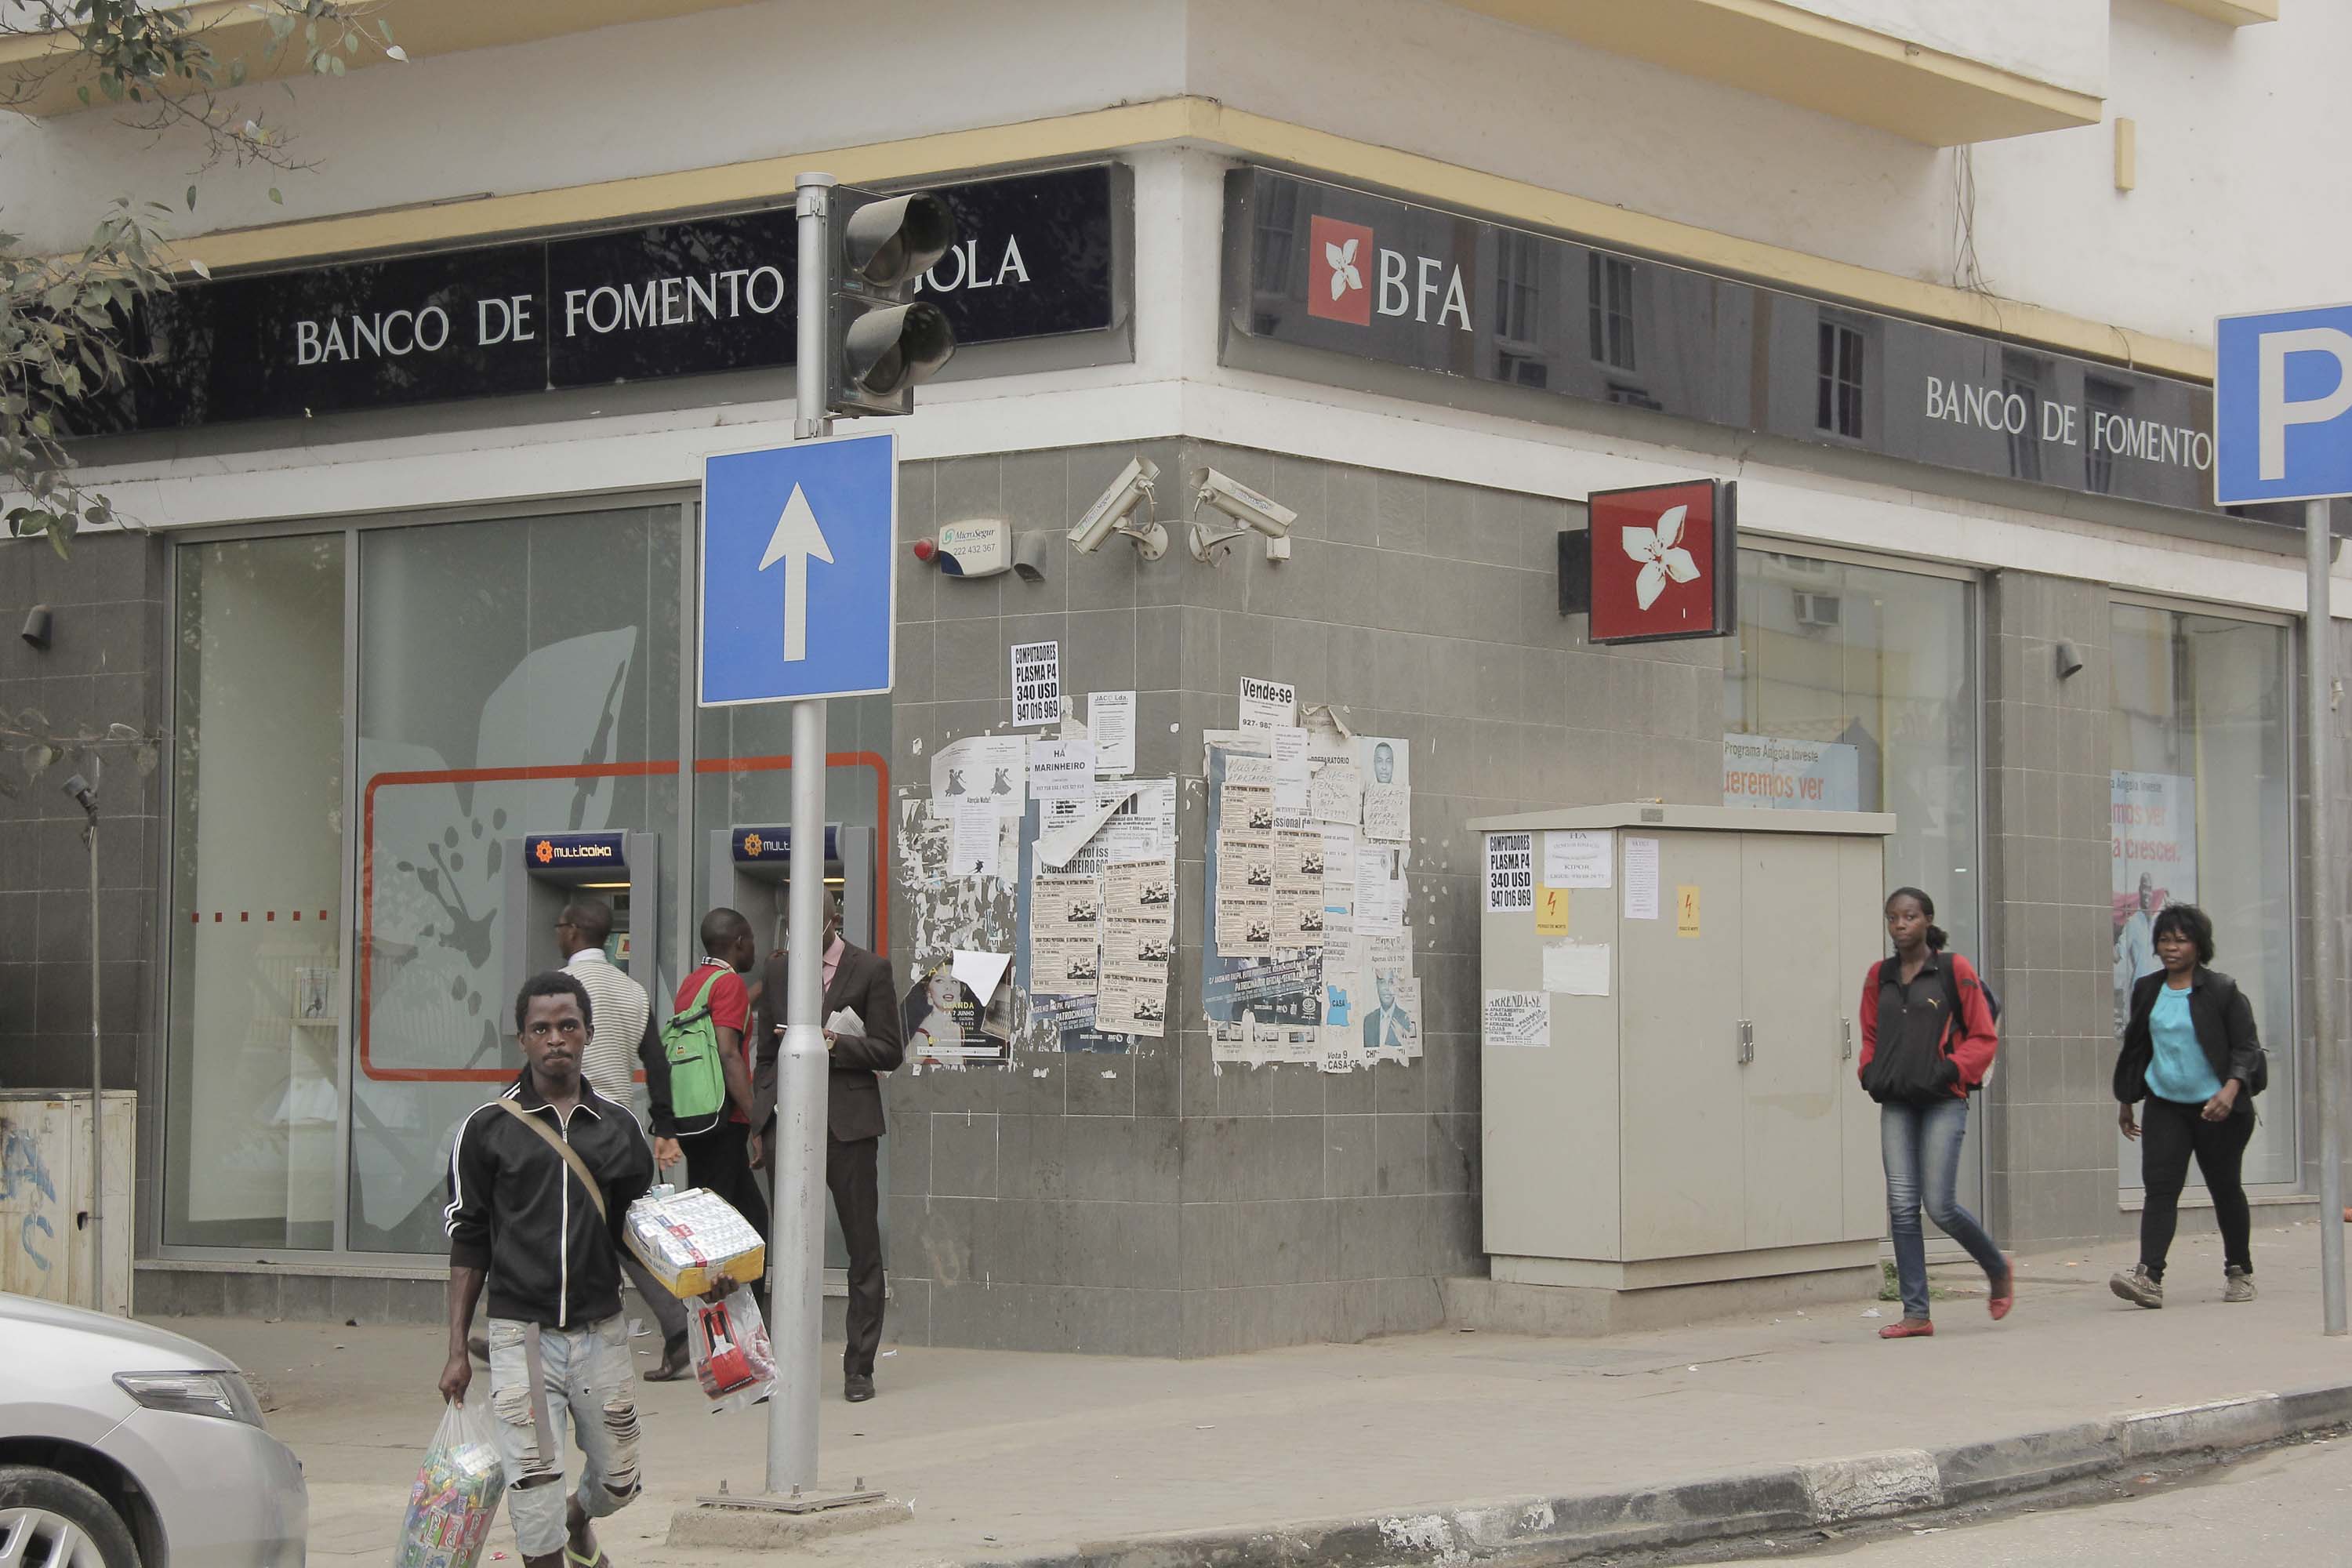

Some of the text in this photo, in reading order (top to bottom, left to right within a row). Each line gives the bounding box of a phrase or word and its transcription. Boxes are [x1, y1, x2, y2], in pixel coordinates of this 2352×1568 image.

[1377, 248, 1472, 332] BFA
[296, 306, 448, 365] BANCO
[478, 295, 534, 346] DE
[564, 266, 783, 337] FOMENTO
[2259, 327, 2352, 481] P
[1926, 376, 2212, 470] BANCO DE FOMENTO
[953, 543, 996, 555] 222 432 367
[1015, 644, 1056, 664] COMPUTADORES
[1016, 663, 1056, 683] PLASMA P4
[1017, 682, 1057, 701] 340 USD
[1243, 678, 1292, 703] Vende-se
[1017, 700, 1058, 721] 947 016 969
[1724, 742, 1819, 763] Programa Angola Investe
[1034, 761, 1085, 771] MARINHEIRO
[1798, 776, 1824, 800] ver
[1490, 835, 1530, 852] COMPUTADORES
[1490, 853, 1530, 869] PLASMA P4
[1491, 872, 1530, 887] 340 USD
[1492, 889, 1530, 907] 947 016 969
